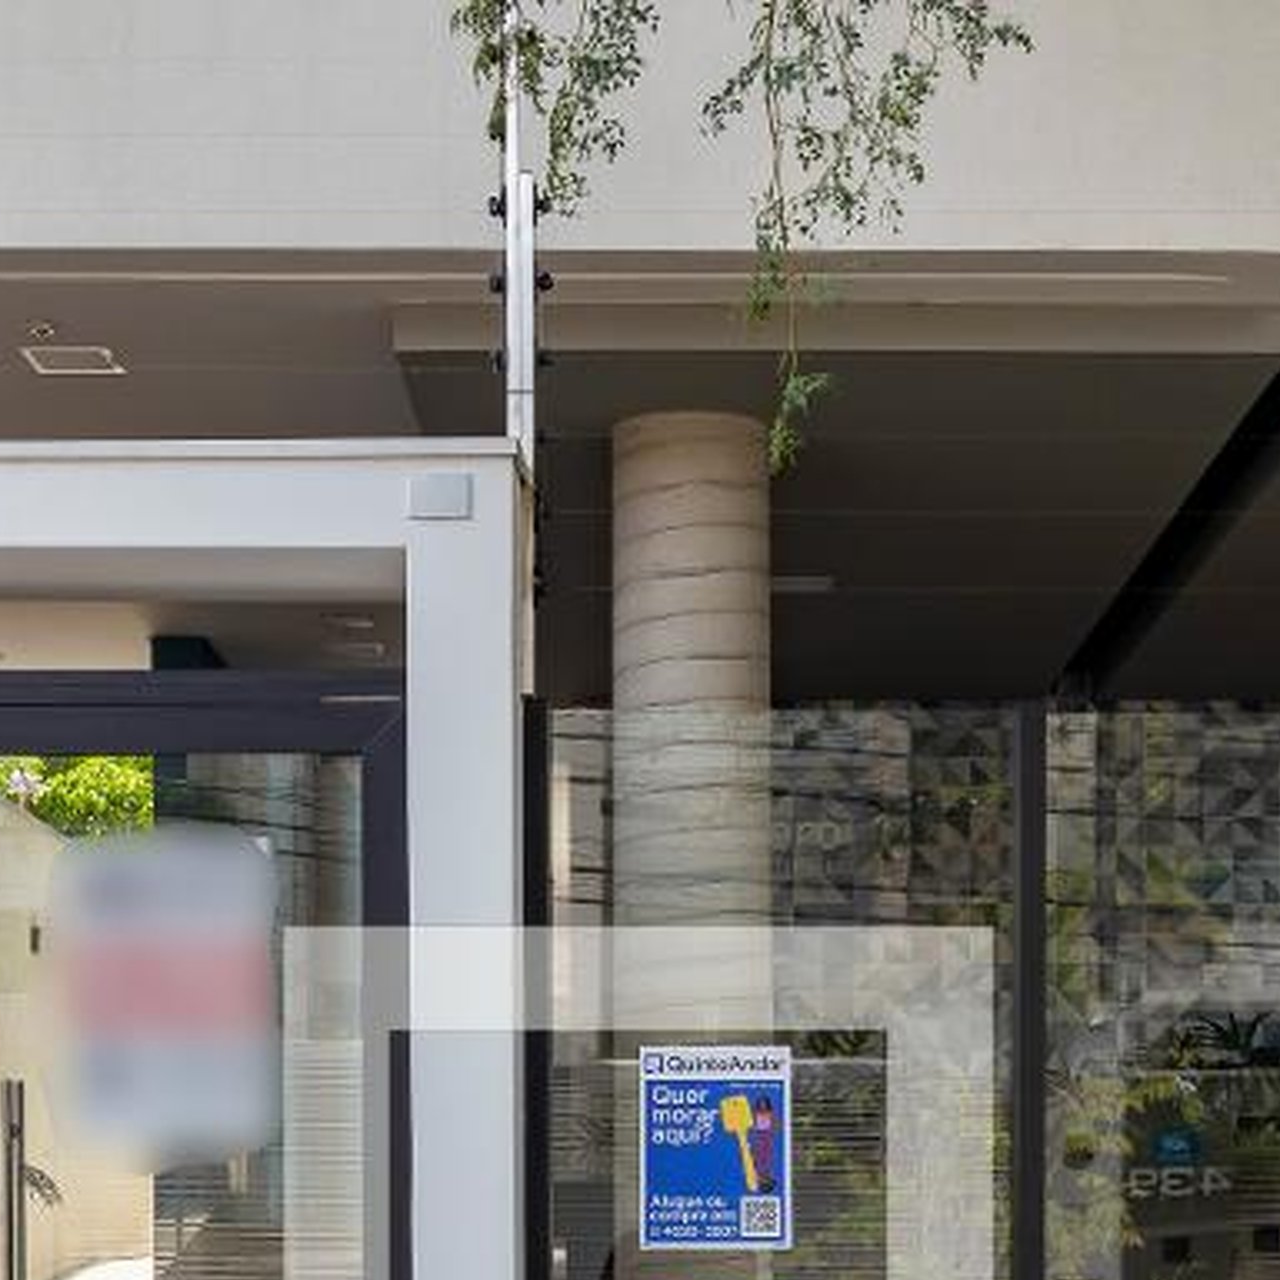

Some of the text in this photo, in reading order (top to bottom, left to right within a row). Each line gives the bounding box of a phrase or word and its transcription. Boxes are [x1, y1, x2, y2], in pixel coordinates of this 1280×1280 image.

[666, 1055, 782, 1071] QuintoAndar
[651, 1085, 710, 1105] Quer
[652, 1108, 719, 1124] morar
[651, 1128, 715, 1146] aqui?
